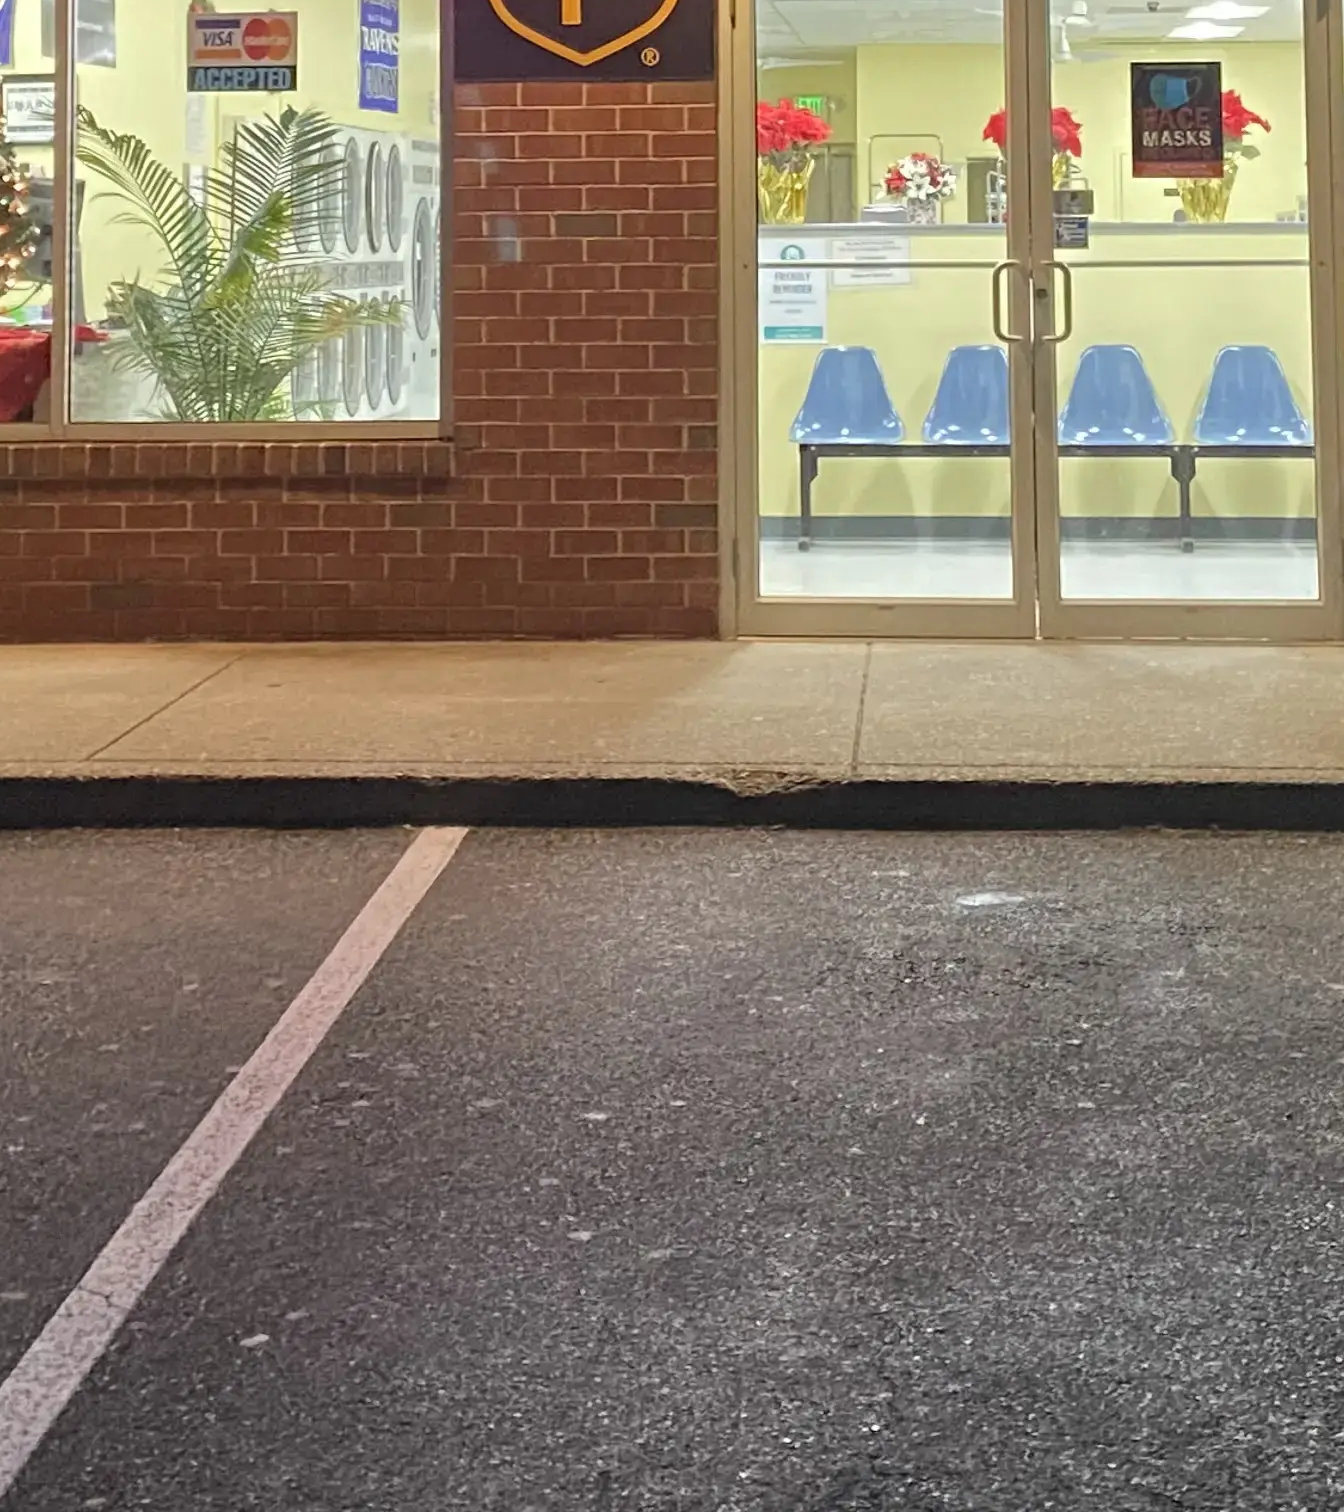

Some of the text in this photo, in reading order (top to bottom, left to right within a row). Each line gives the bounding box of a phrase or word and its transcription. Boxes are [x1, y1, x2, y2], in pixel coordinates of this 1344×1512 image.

[202, 31, 233, 47] VISA
[194, 68, 292, 90] ACCEPTED
[1142, 106, 1212, 129] FACE
[1142, 130, 1212, 148] MASKS
